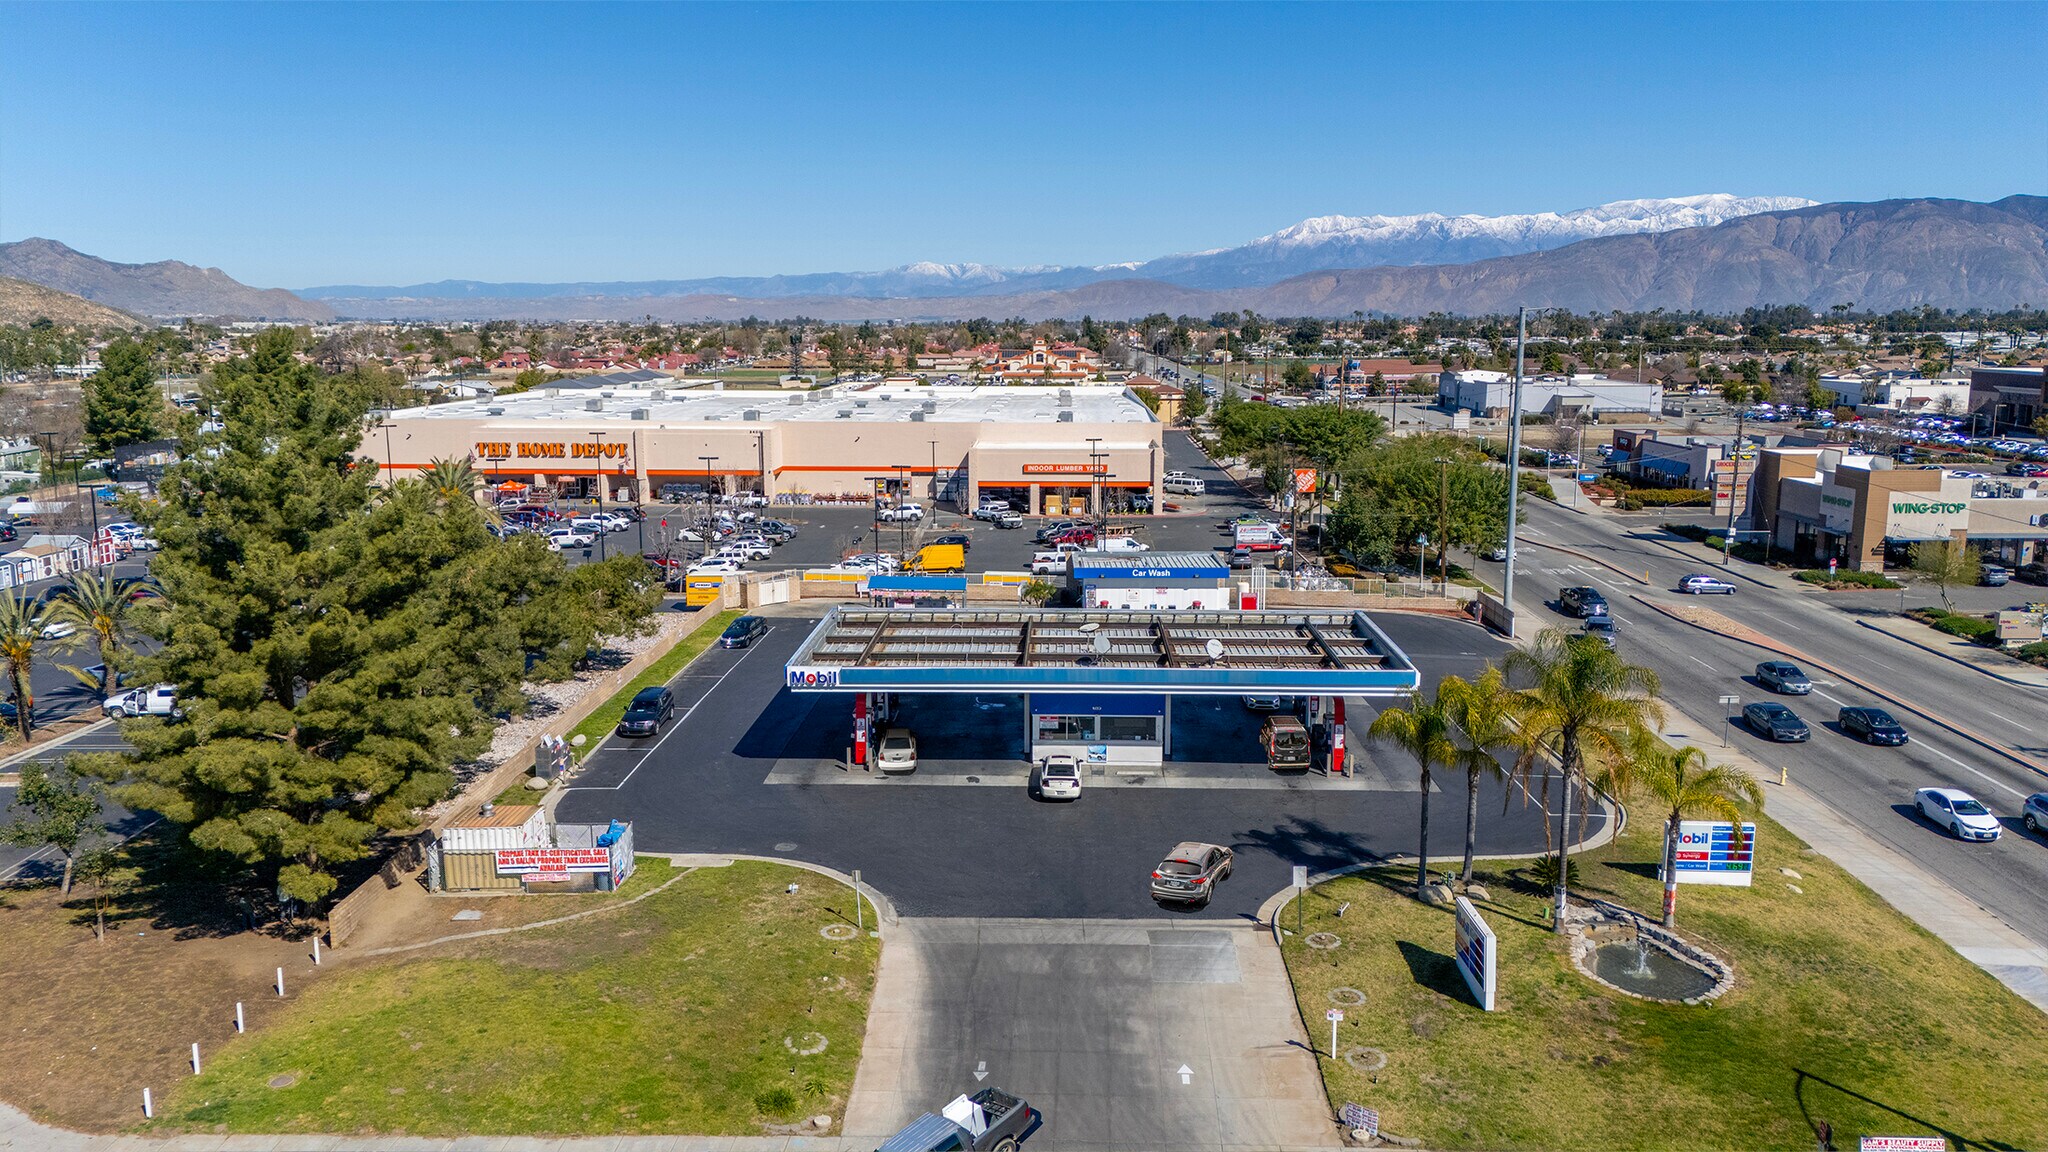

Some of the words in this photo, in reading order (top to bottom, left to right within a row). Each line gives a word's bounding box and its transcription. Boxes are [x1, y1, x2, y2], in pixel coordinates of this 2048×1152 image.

[475, 442, 511, 458] THE
[517, 442, 565, 458] HOME
[571, 442, 628, 459] DEPOT
[1132, 569, 1147, 577] Car
[1148, 569, 1171, 577] Wash
[791, 671, 837, 684] Mobil
